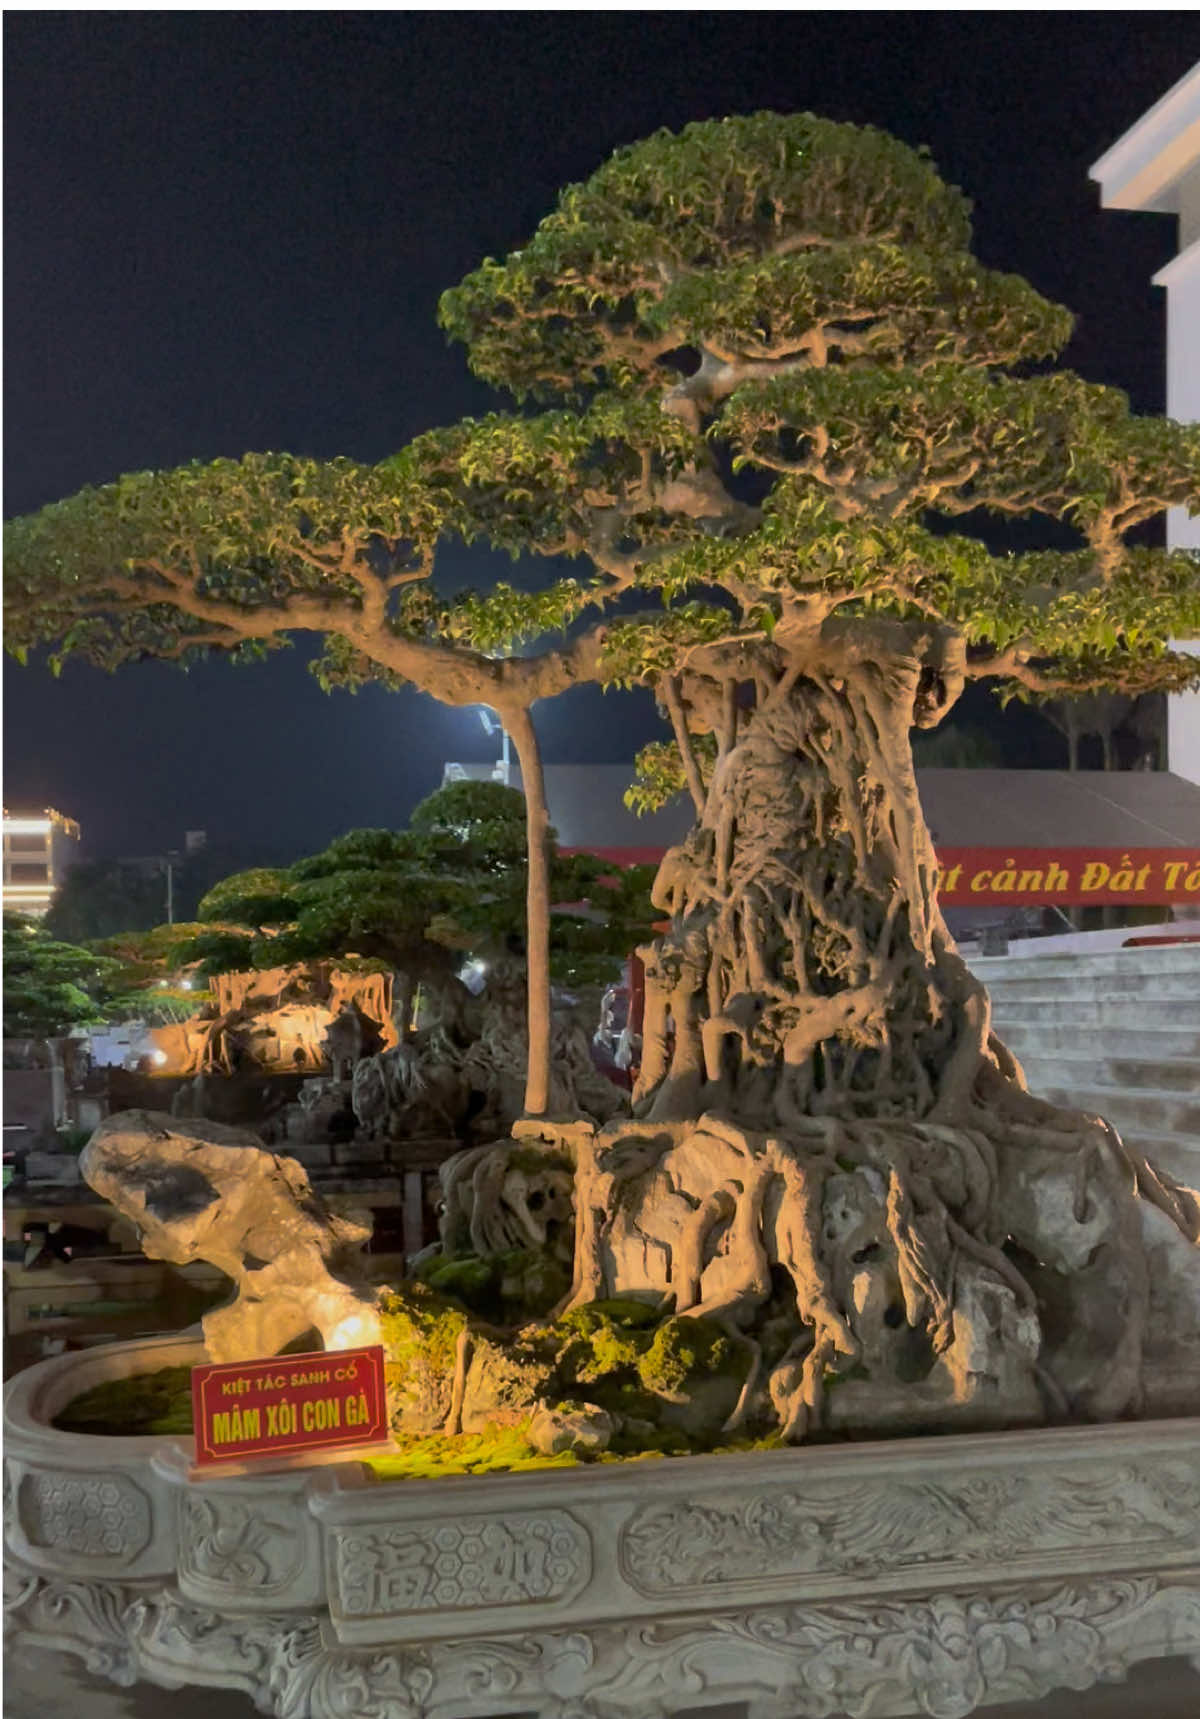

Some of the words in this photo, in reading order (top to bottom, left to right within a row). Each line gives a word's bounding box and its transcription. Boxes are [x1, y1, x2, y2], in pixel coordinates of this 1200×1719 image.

[971, 858, 1069, 892] cảnh
[1080, 853, 1151, 892] Đất
[222, 1377, 251, 1396] KIỆT
[256, 1373, 287, 1391] TÁC
[291, 1368, 330, 1387] SANH
[213, 1404, 261, 1444] MÂM
[266, 1398, 297, 1437] XÔI
[303, 1397, 340, 1432] CON
[345, 1386, 370, 1425] GÀ
